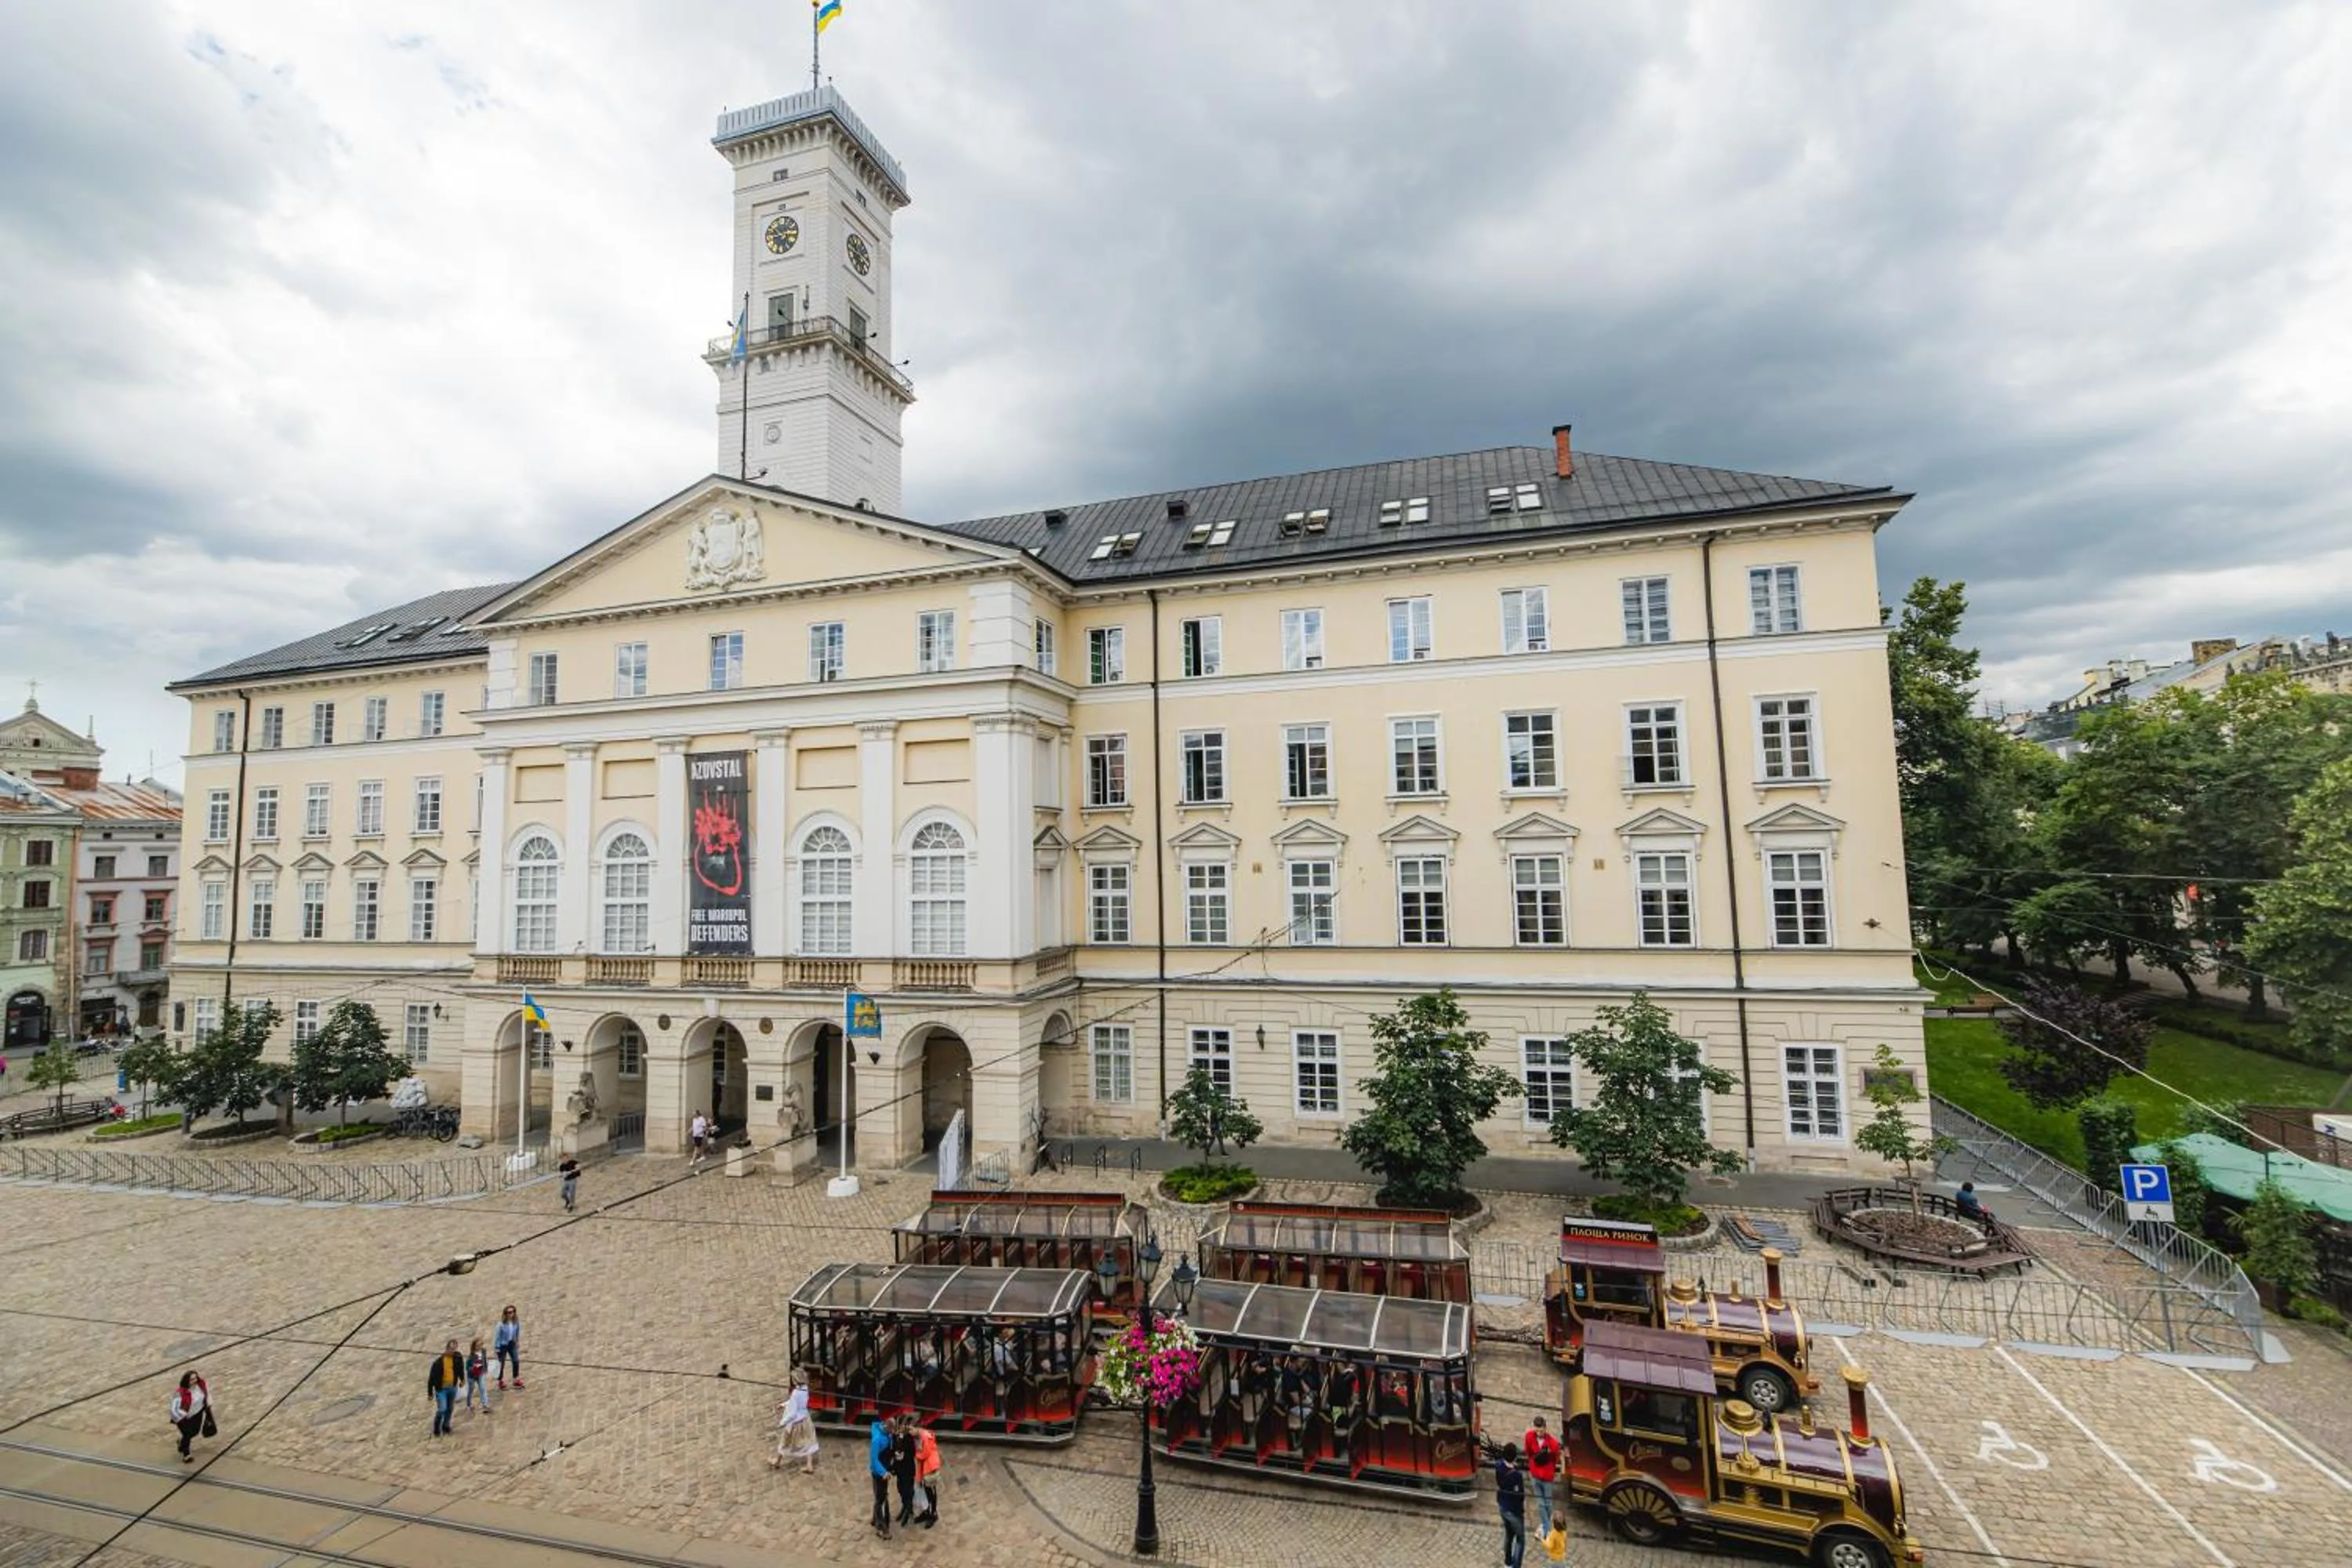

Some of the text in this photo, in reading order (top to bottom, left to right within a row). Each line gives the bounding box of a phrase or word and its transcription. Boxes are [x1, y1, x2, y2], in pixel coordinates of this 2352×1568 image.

[691, 759, 742, 780] AZOVSTAL
[691, 909, 704, 921] FREE
[691, 924, 749, 942] DEFENDERS
[2132, 1169, 2159, 1199] P
[1570, 1227, 1650, 1243] ПЛОЩА РИНОК
